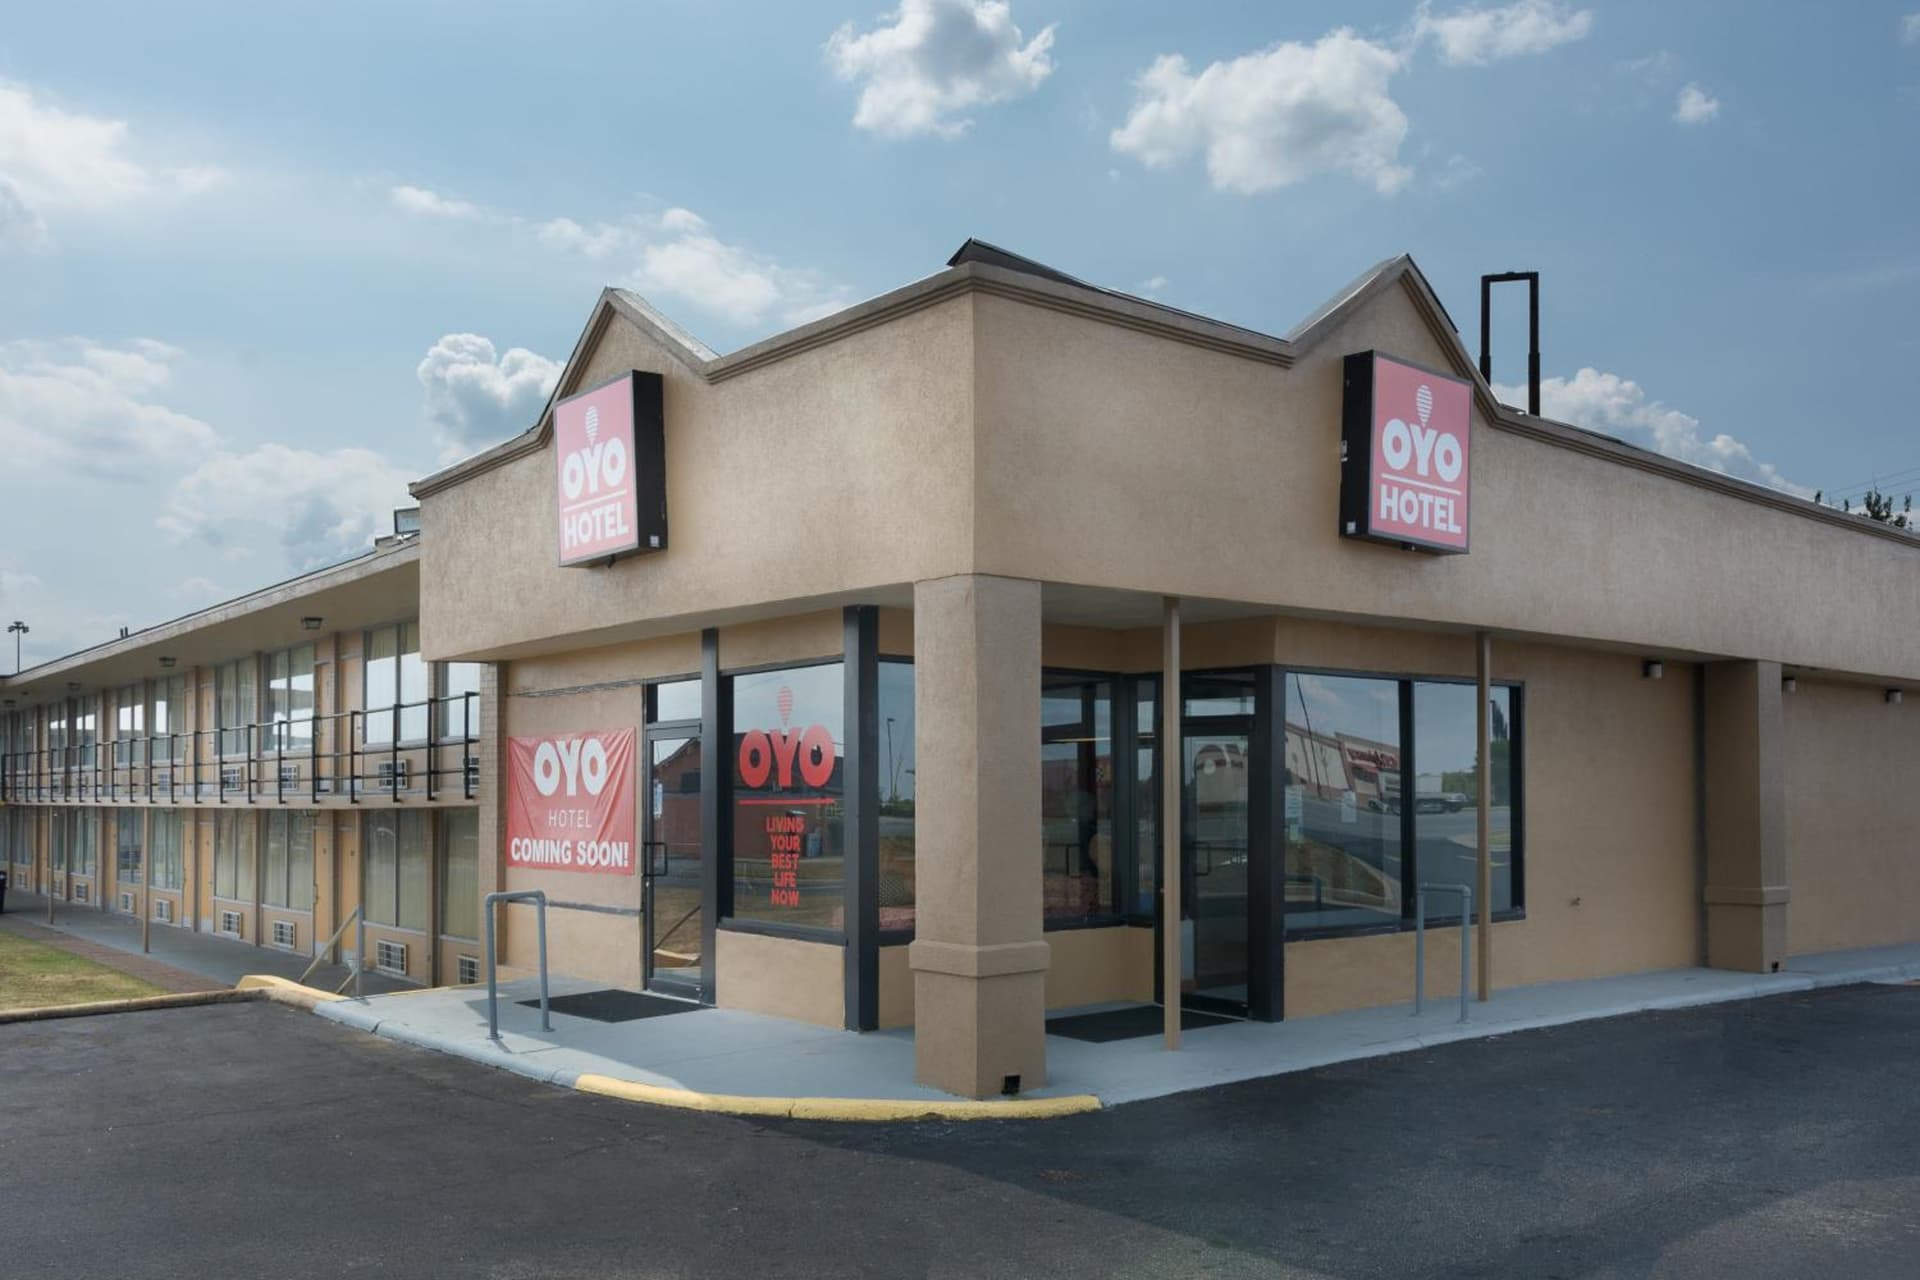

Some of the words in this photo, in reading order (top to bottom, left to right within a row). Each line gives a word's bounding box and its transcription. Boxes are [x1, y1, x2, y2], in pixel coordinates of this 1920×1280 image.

[1382, 418, 1462, 483] OYO
[563, 437, 627, 499] OYO
[1380, 484, 1462, 534] HOTEL
[564, 502, 629, 549] HOTEL
[533, 738, 608, 796] OYO
[739, 725, 835, 788] OYO
[548, 808, 593, 828] HOTEL
[765, 815, 805, 833] LIVING
[511, 837, 572, 864] COMING
[576, 840, 630, 867] SOON!
[770, 834, 801, 851] YOUR
[771, 853, 800, 869] BEST
[774, 871, 798, 888] LIFE
[771, 889, 800, 907] NOW
